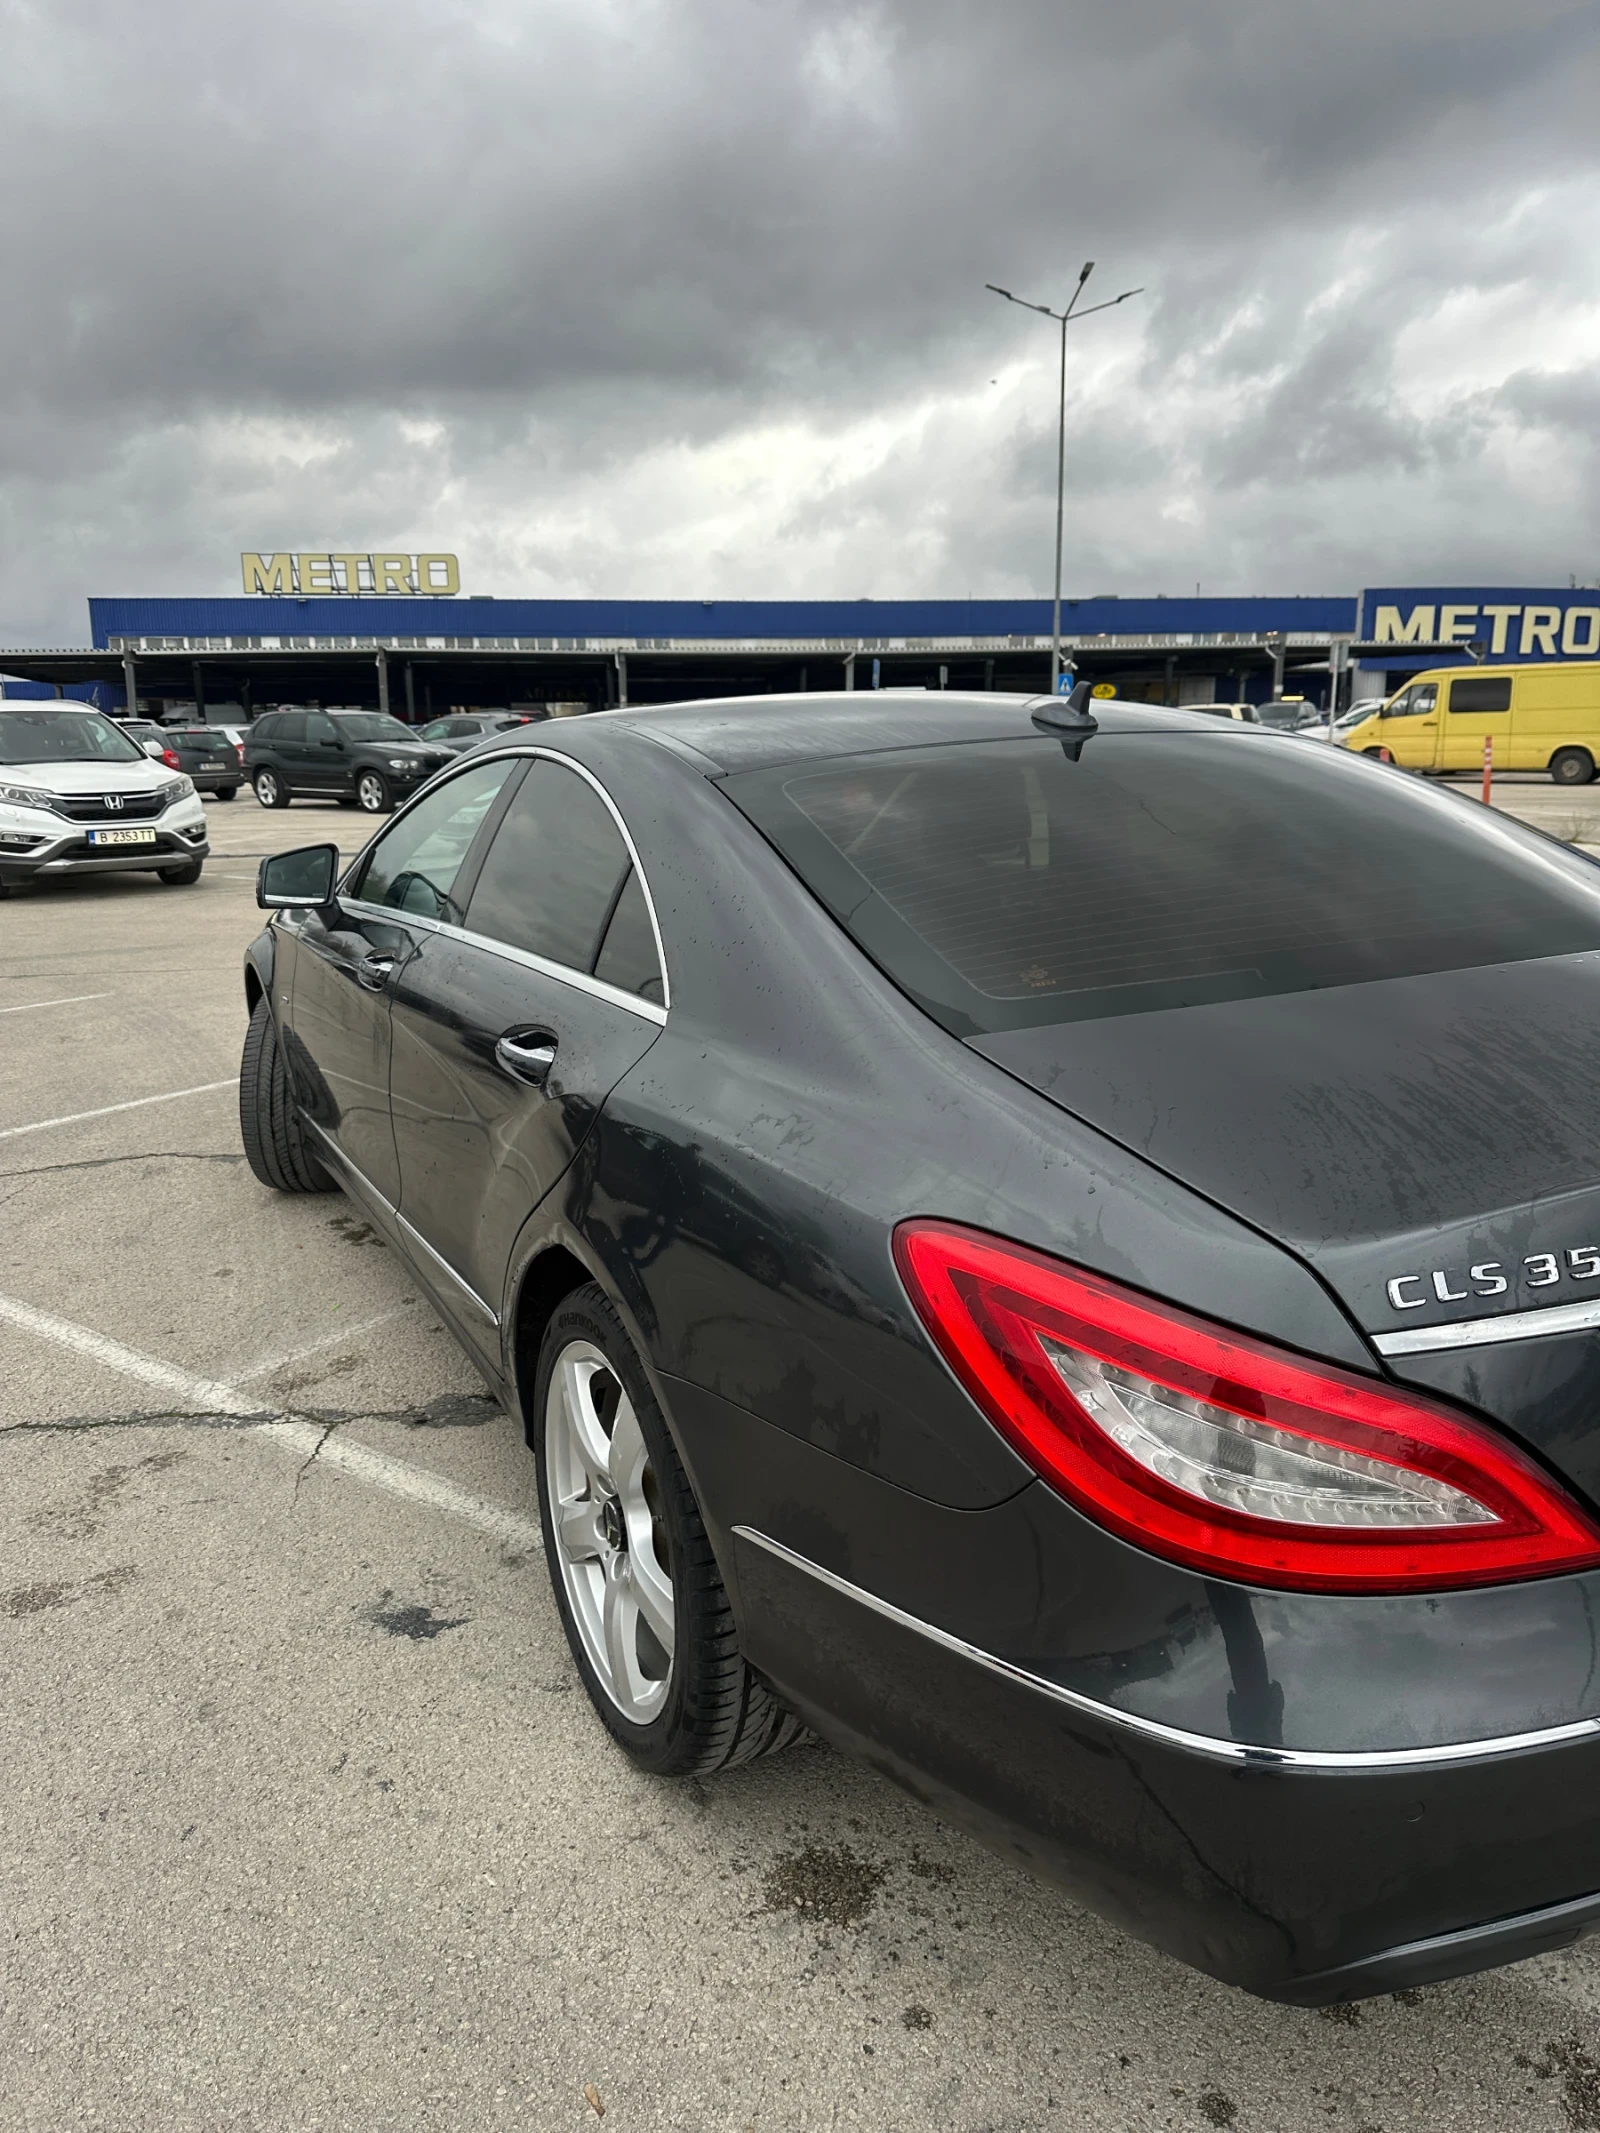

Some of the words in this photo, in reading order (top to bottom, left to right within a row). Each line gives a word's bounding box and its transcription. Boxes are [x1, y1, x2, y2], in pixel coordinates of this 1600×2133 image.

[241, 553, 460, 594] METRO
[1374, 605, 1600, 655] METRO
[1387, 1262, 1508, 1310] CLS
